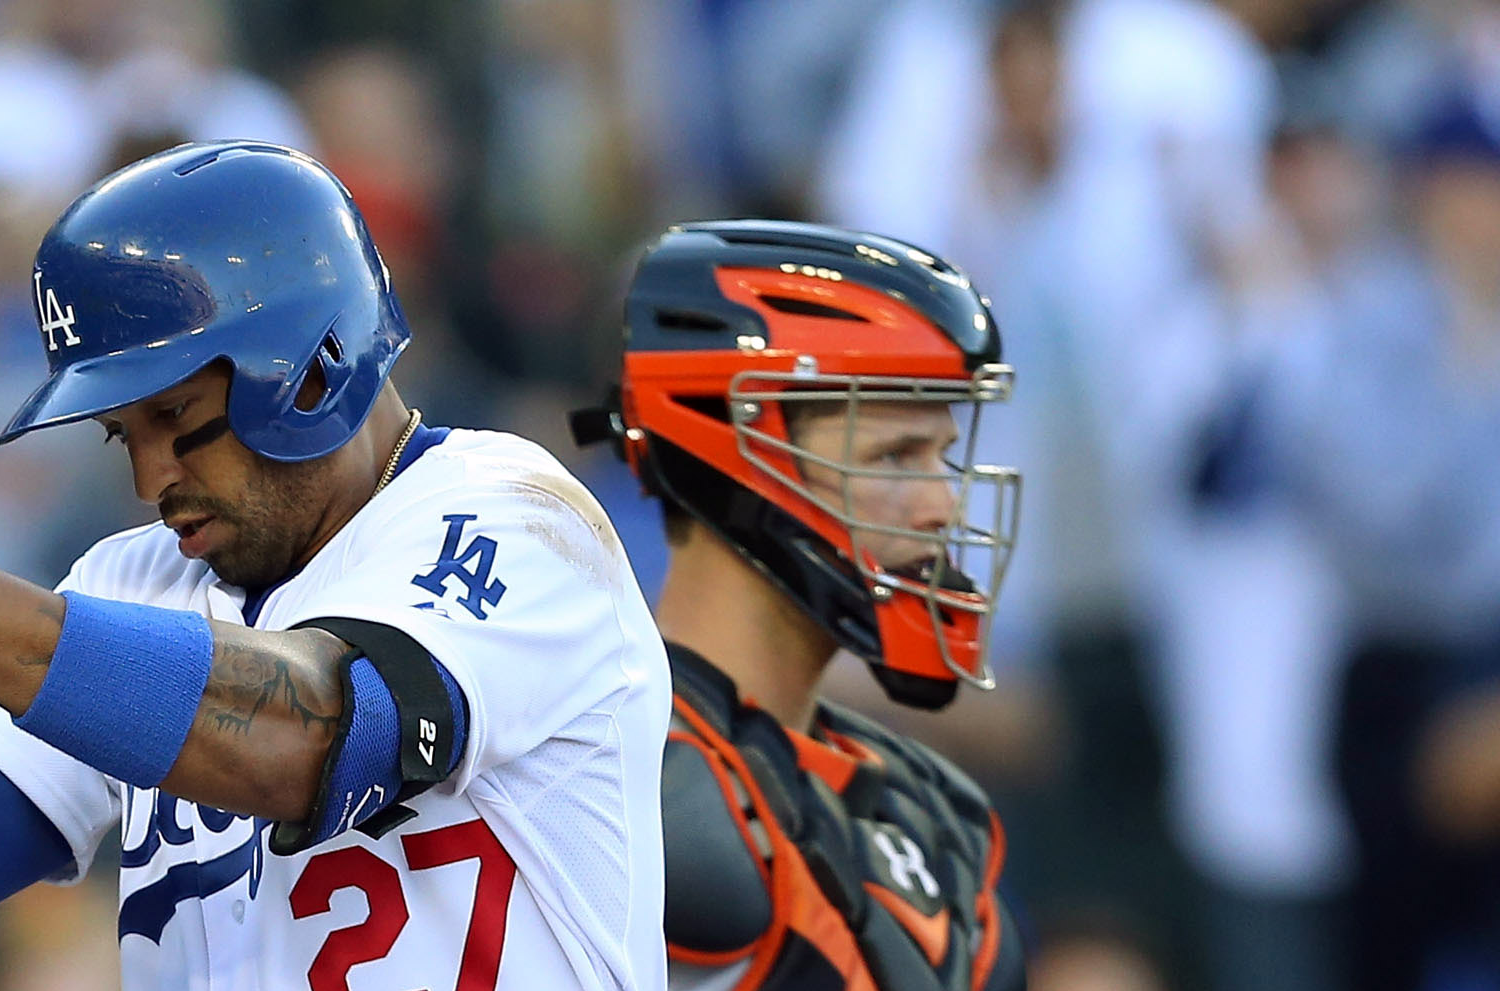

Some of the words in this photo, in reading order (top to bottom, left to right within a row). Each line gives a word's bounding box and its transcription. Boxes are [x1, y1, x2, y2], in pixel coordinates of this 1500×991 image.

[34, 271, 81, 351] LA
[410, 514, 508, 621] LA
[418, 717, 437, 767] 27
